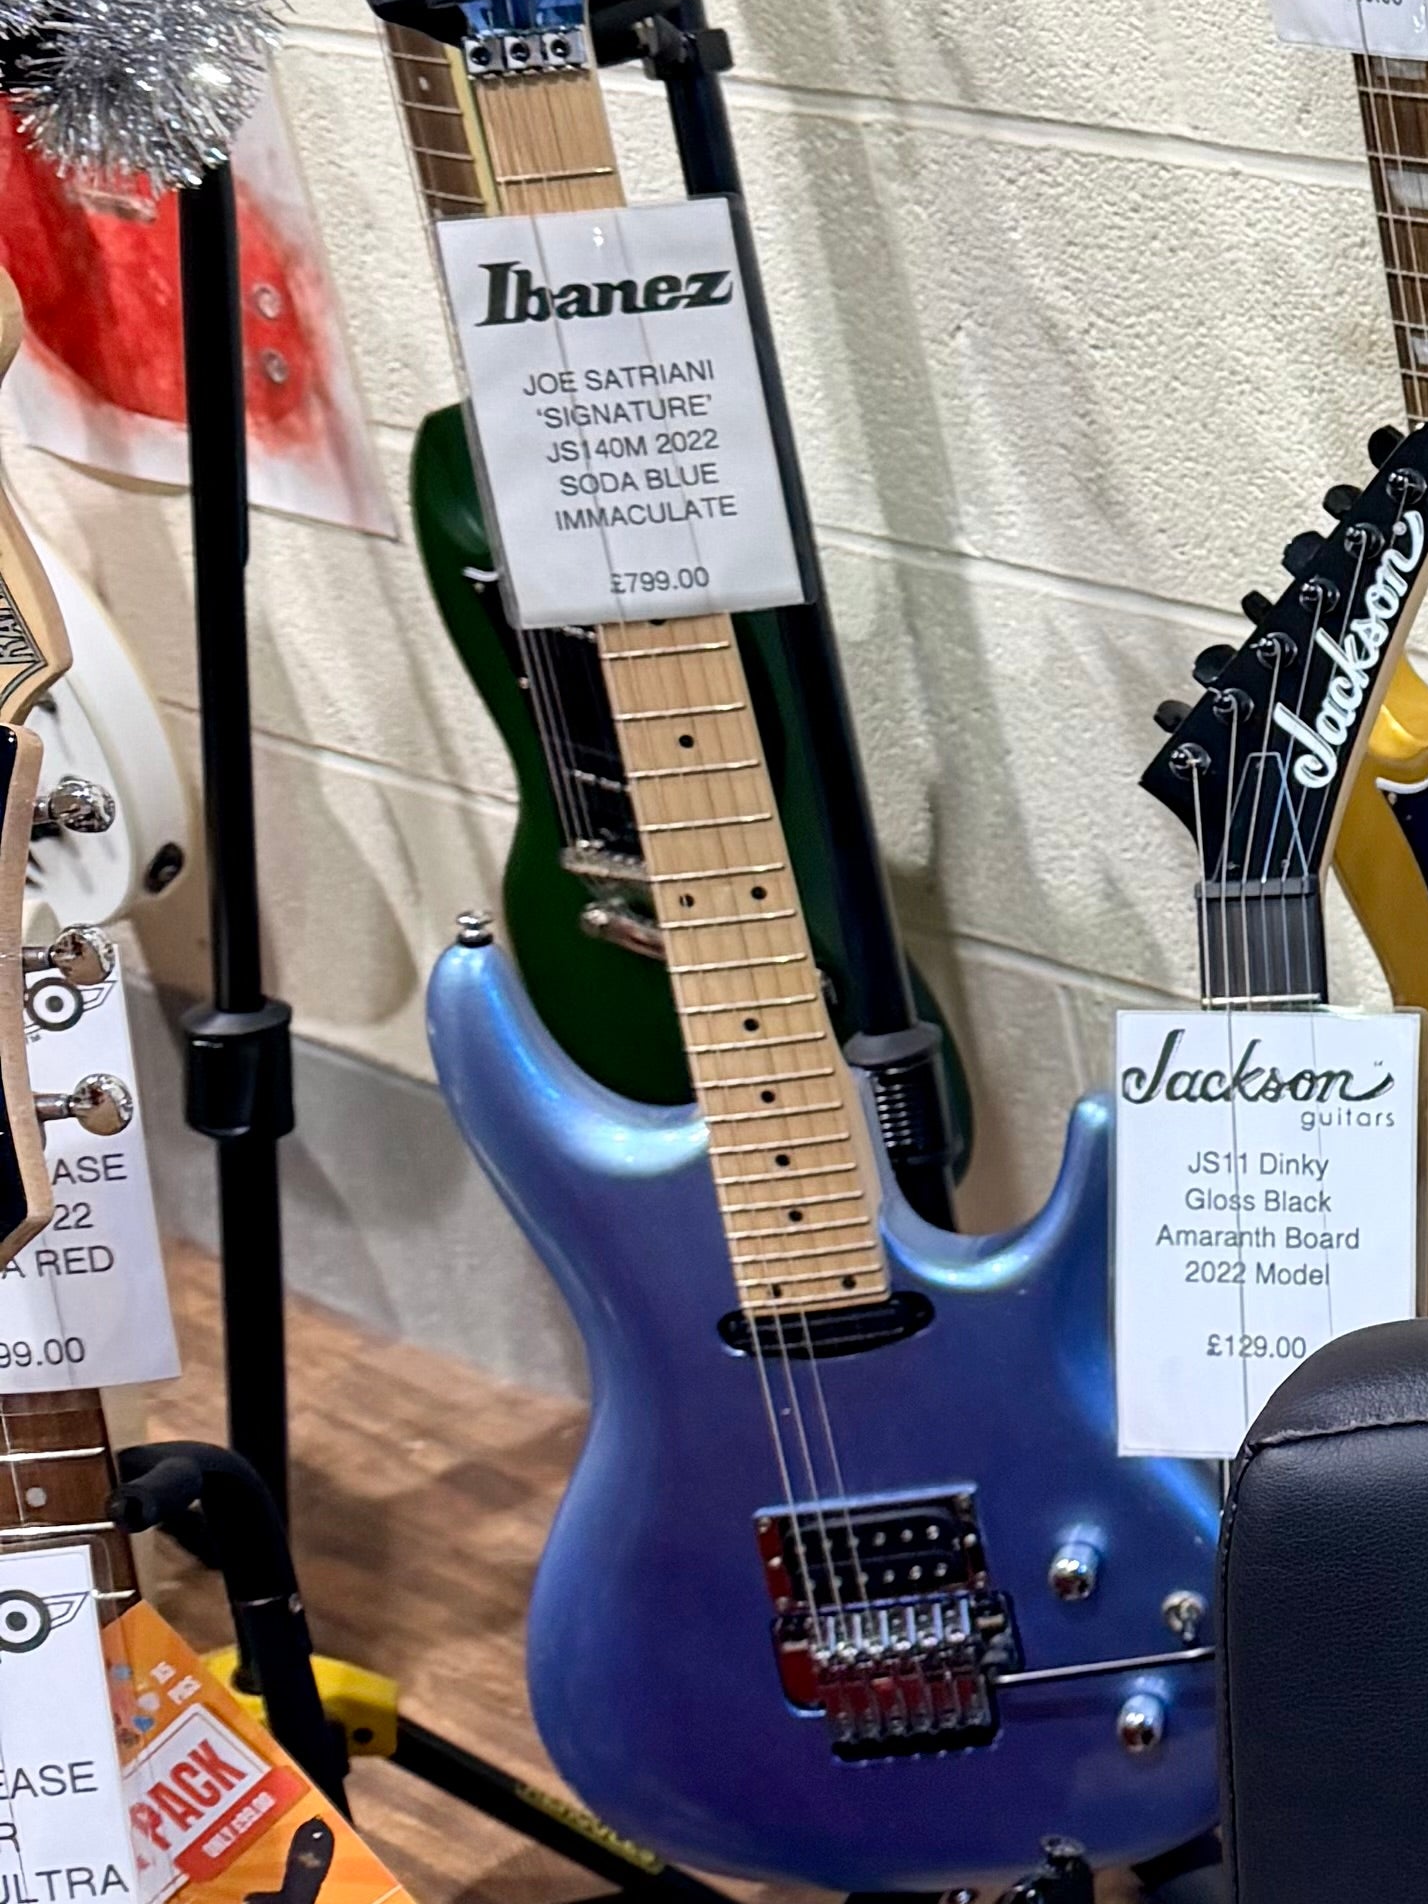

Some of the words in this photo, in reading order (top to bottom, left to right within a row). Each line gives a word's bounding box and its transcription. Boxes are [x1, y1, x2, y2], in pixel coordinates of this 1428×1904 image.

[473, 260, 735, 328] Ibanez
[522, 371, 578, 398] JOE
[585, 359, 716, 391] SATRIANI
[537, 395, 713, 429] 'SIGNATURE'
[546, 436, 649, 465] JS140M
[656, 428, 720, 456] 2022
[560, 471, 640, 497] SODA
[645, 462, 720, 492] BLUE
[555, 495, 738, 532] IMMACULATE
[610, 566, 711, 596] £799.00
[1274, 510, 1424, 790] Jackson
[1121, 1028, 1395, 1105] Jackson
[1300, 1108, 1396, 1132] guitars
[1187, 1151, 1249, 1177] JS11
[1259, 1151, 1330, 1183] Dinky
[1185, 1187, 1256, 1213] Gloss
[1263, 1189, 1332, 1214] Black
[1155, 1223, 1276, 1250] Amaranth
[1285, 1226, 1361, 1251] Board
[35, 1245, 116, 1278] RED
[1184, 1260, 1246, 1286] 2022
[1256, 1261, 1330, 1287] Model
[1206, 1334, 1307, 1360] £129.00
[0, 1760, 98, 1800] ASE
